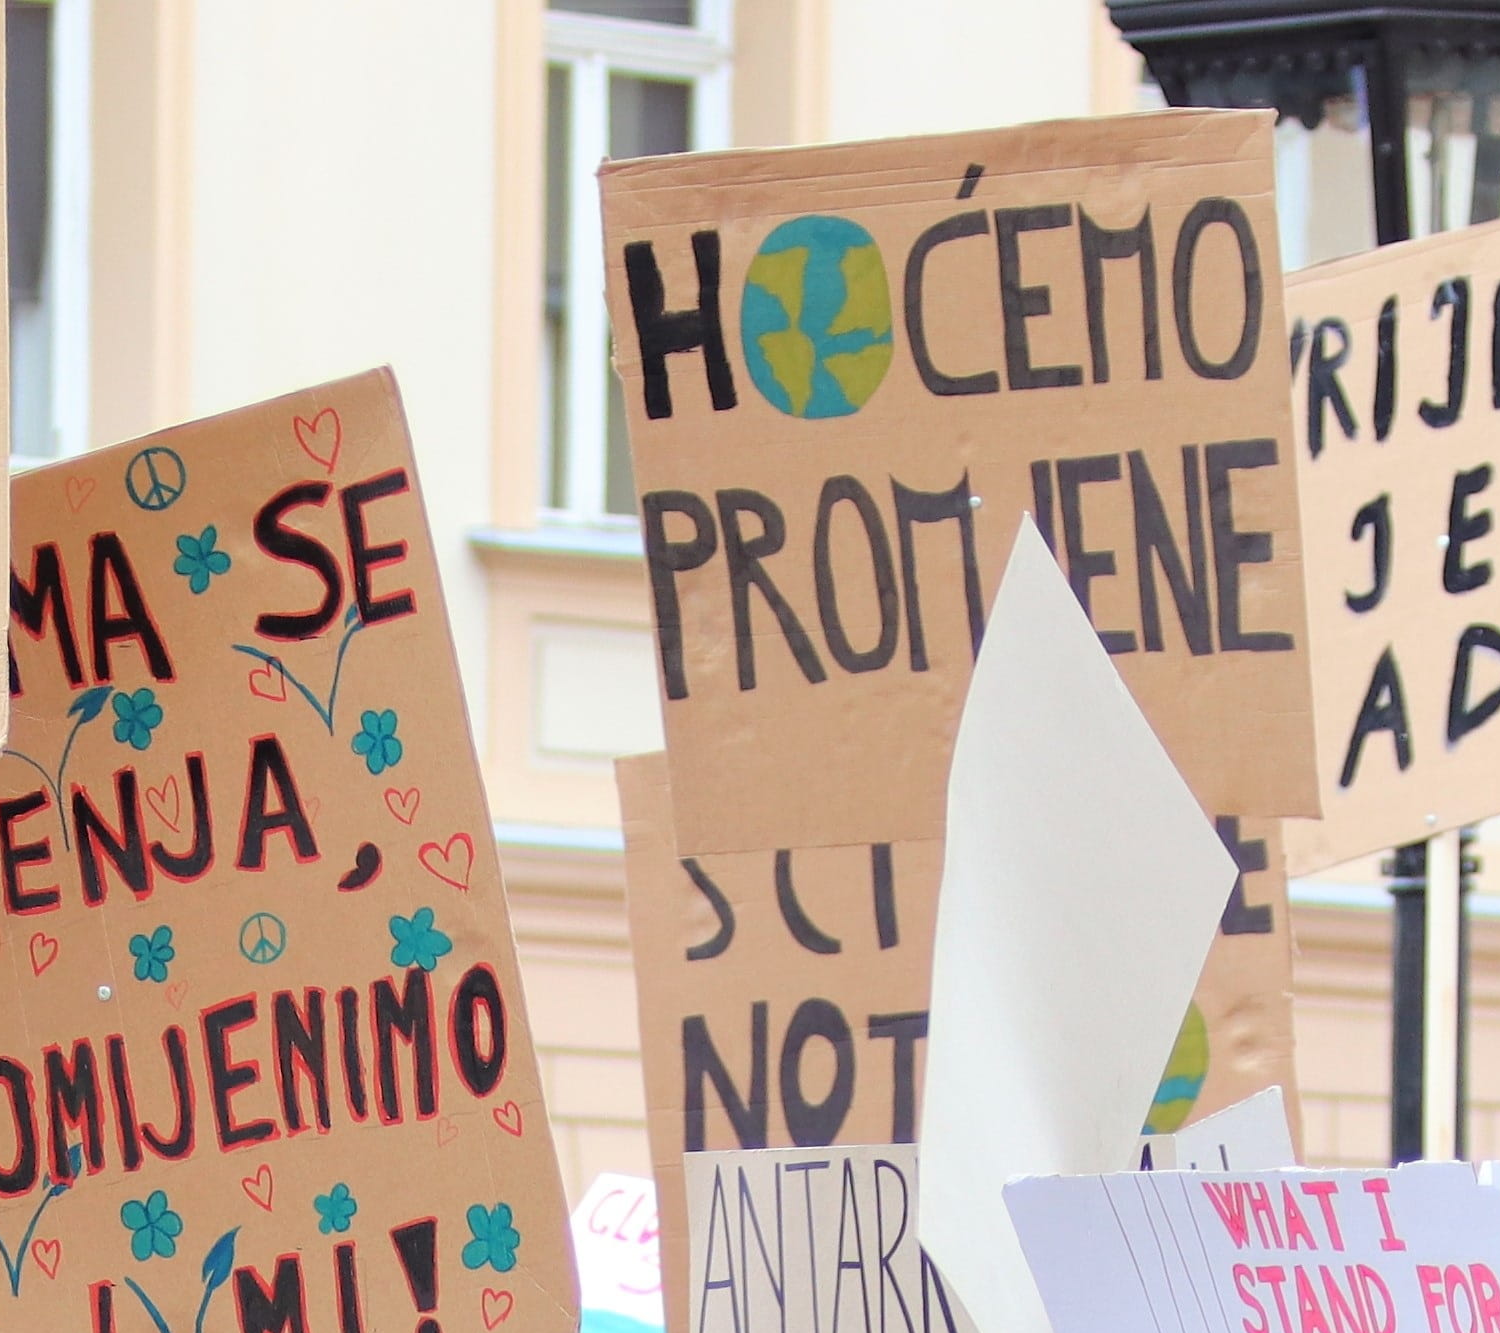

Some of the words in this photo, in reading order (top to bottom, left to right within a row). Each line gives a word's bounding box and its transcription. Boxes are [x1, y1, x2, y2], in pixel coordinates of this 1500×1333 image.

[253, 467, 418, 642] SE
[1344, 463, 1496, 615] JE
[1200, 1180, 1346, 1253] WHAT
[1363, 1177, 1408, 1253] I
